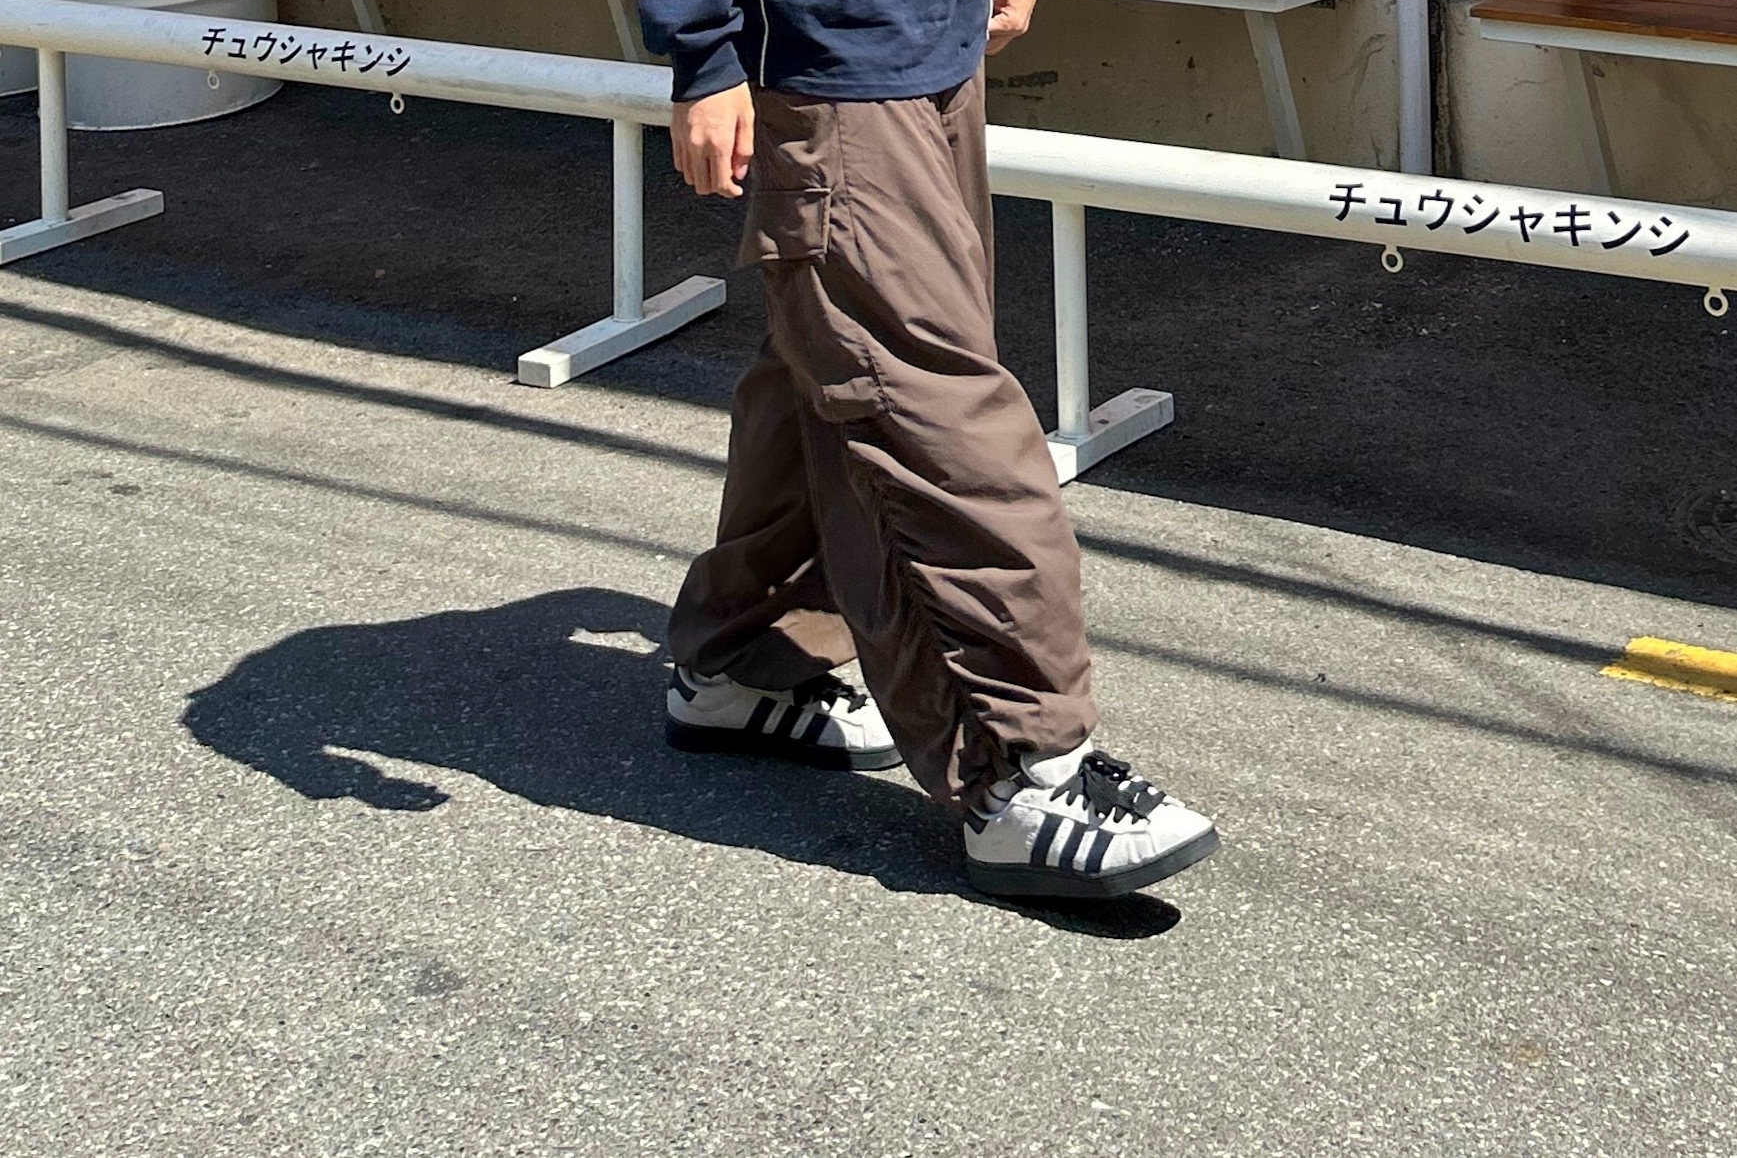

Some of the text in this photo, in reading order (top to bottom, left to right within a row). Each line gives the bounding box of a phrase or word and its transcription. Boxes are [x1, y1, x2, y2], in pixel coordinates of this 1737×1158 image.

[201, 28, 411, 77] チュウシャキンシ
[1329, 182, 1691, 257] チュウシャキンシ
